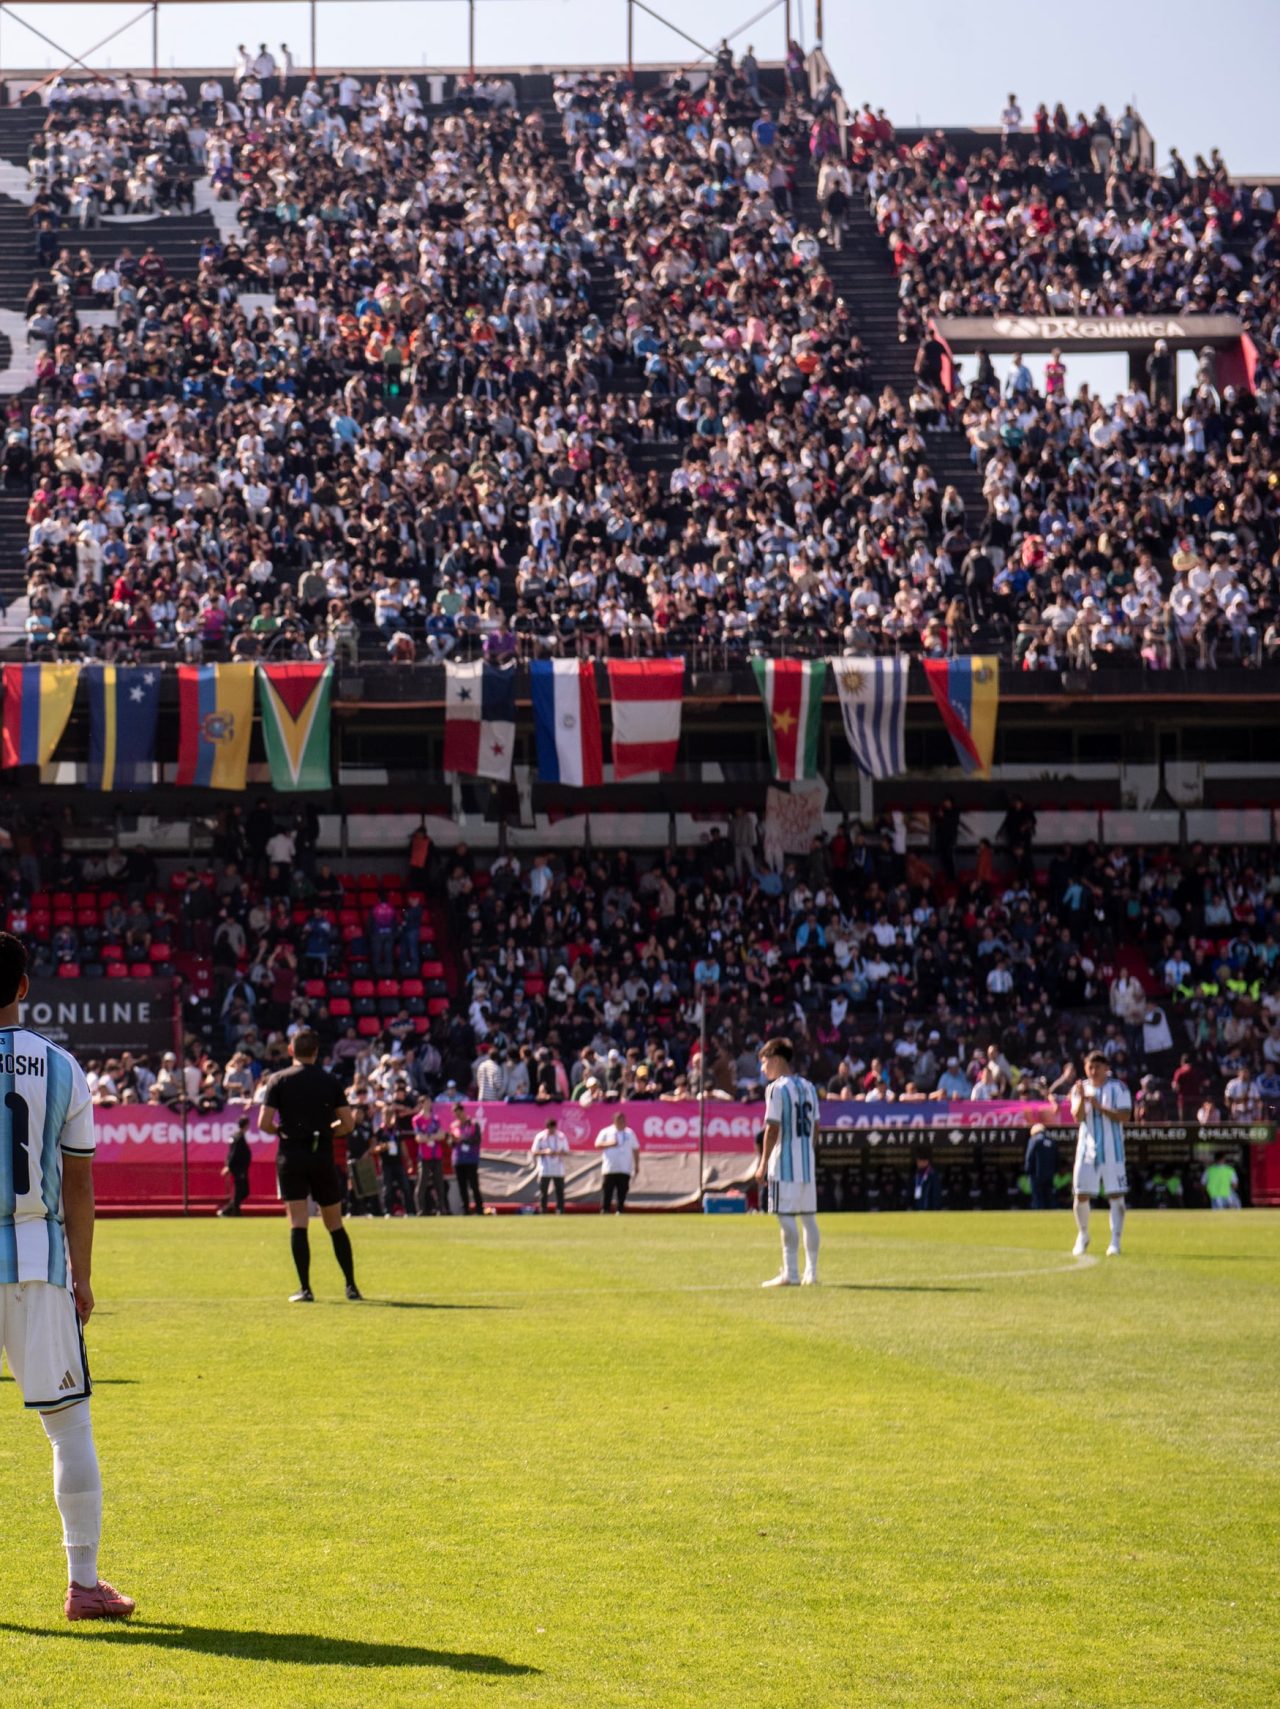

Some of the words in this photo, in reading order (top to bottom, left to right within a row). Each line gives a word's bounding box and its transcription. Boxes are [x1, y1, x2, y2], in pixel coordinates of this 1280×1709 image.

[32, 1003, 150, 1024] ONLINE
[643, 1115, 765, 1139] ROSARI
[795, 1101, 812, 1138] 16
